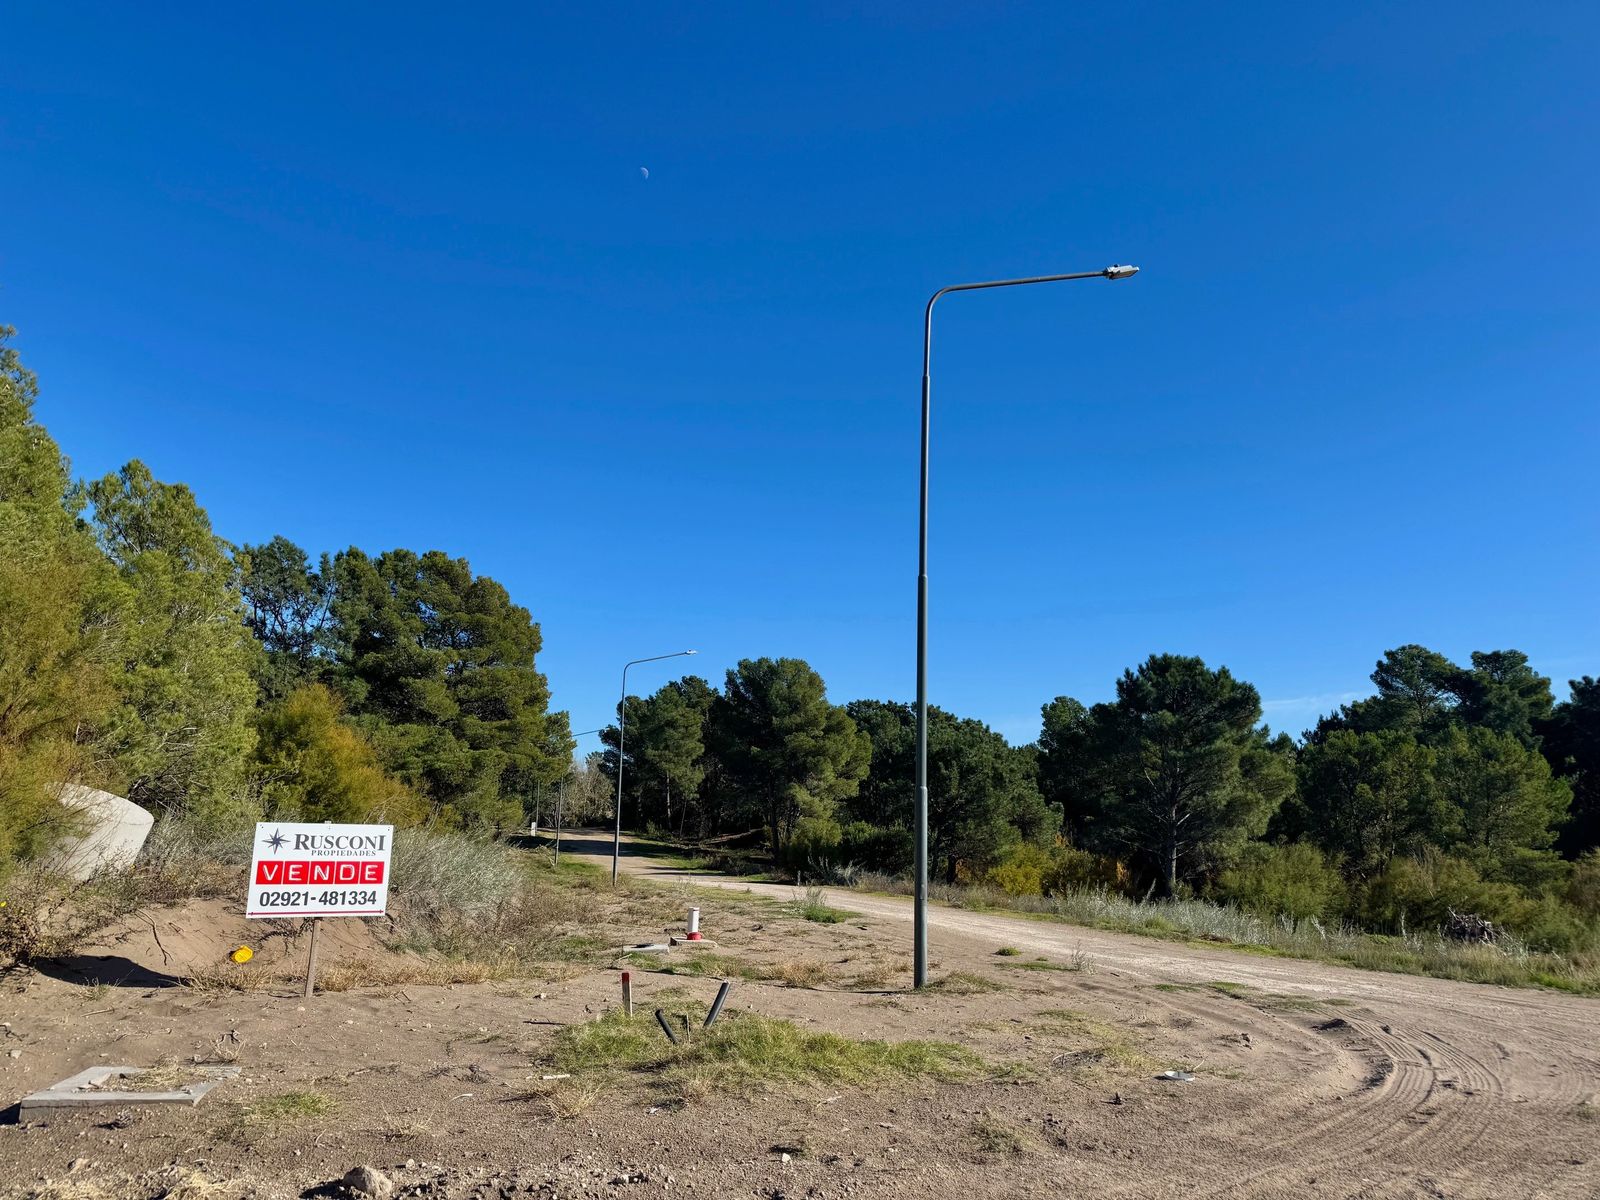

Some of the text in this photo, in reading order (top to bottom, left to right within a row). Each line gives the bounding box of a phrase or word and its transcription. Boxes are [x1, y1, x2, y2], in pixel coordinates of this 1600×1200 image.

[294, 833, 386, 851] RUSCONI
[263, 864, 378, 881] VENDE
[260, 891, 377, 906] 02921-481334
